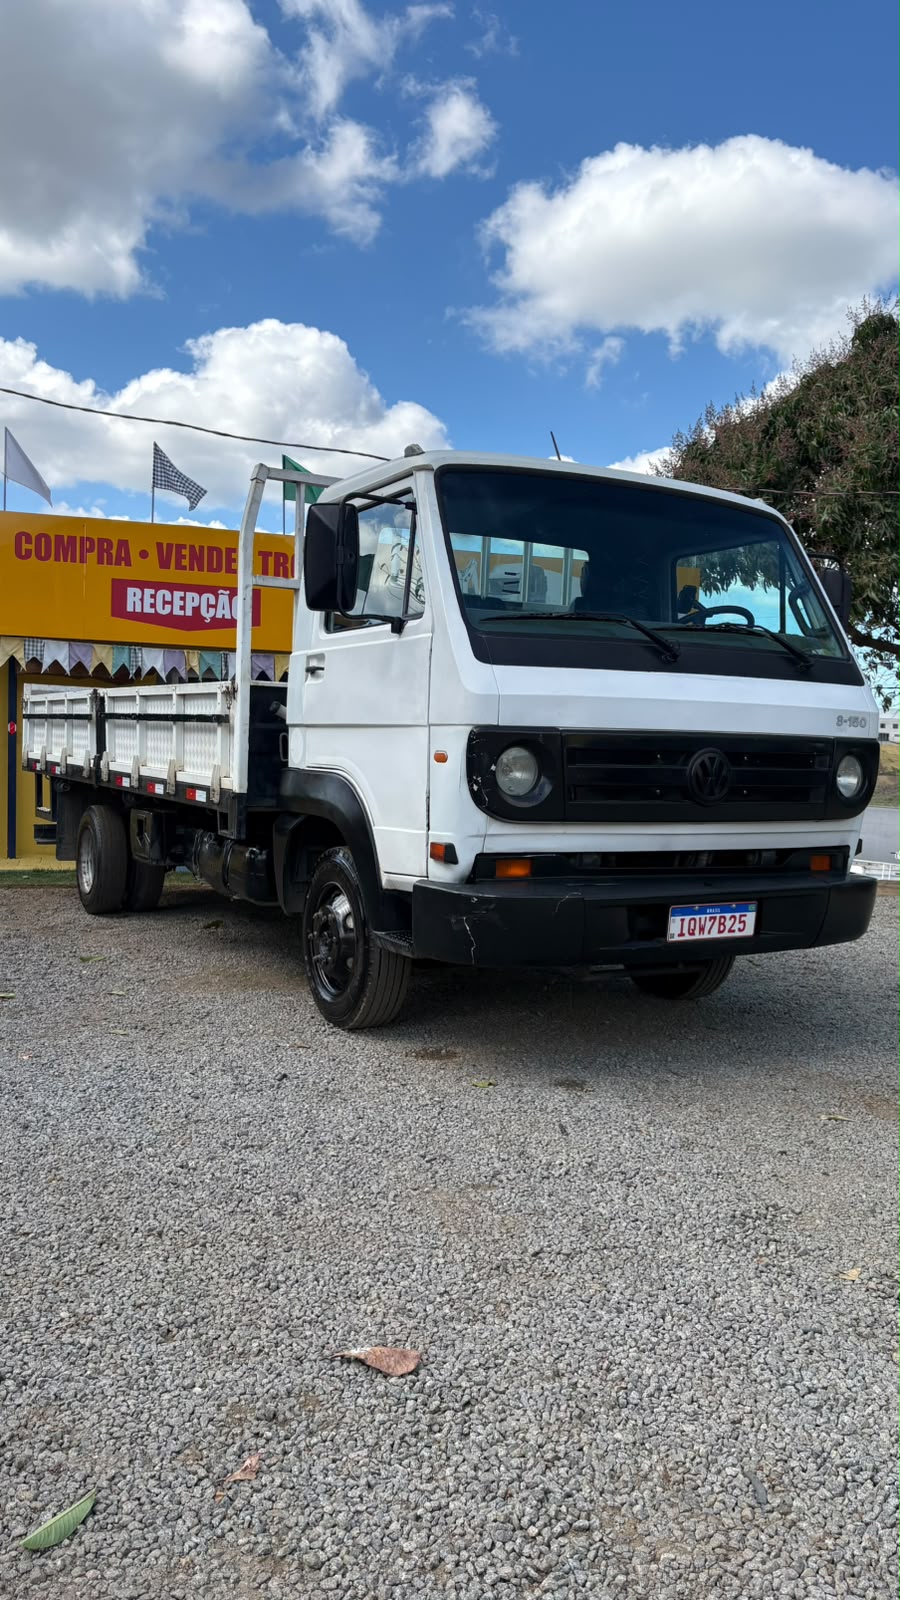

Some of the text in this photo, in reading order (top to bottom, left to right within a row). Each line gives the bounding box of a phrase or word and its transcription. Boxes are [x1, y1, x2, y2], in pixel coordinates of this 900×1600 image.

[14, 531, 295, 579] COMPRA VENDE TR
[836, 715, 867, 729] 8-150
[677, 914, 748, 938] IQW7B25
